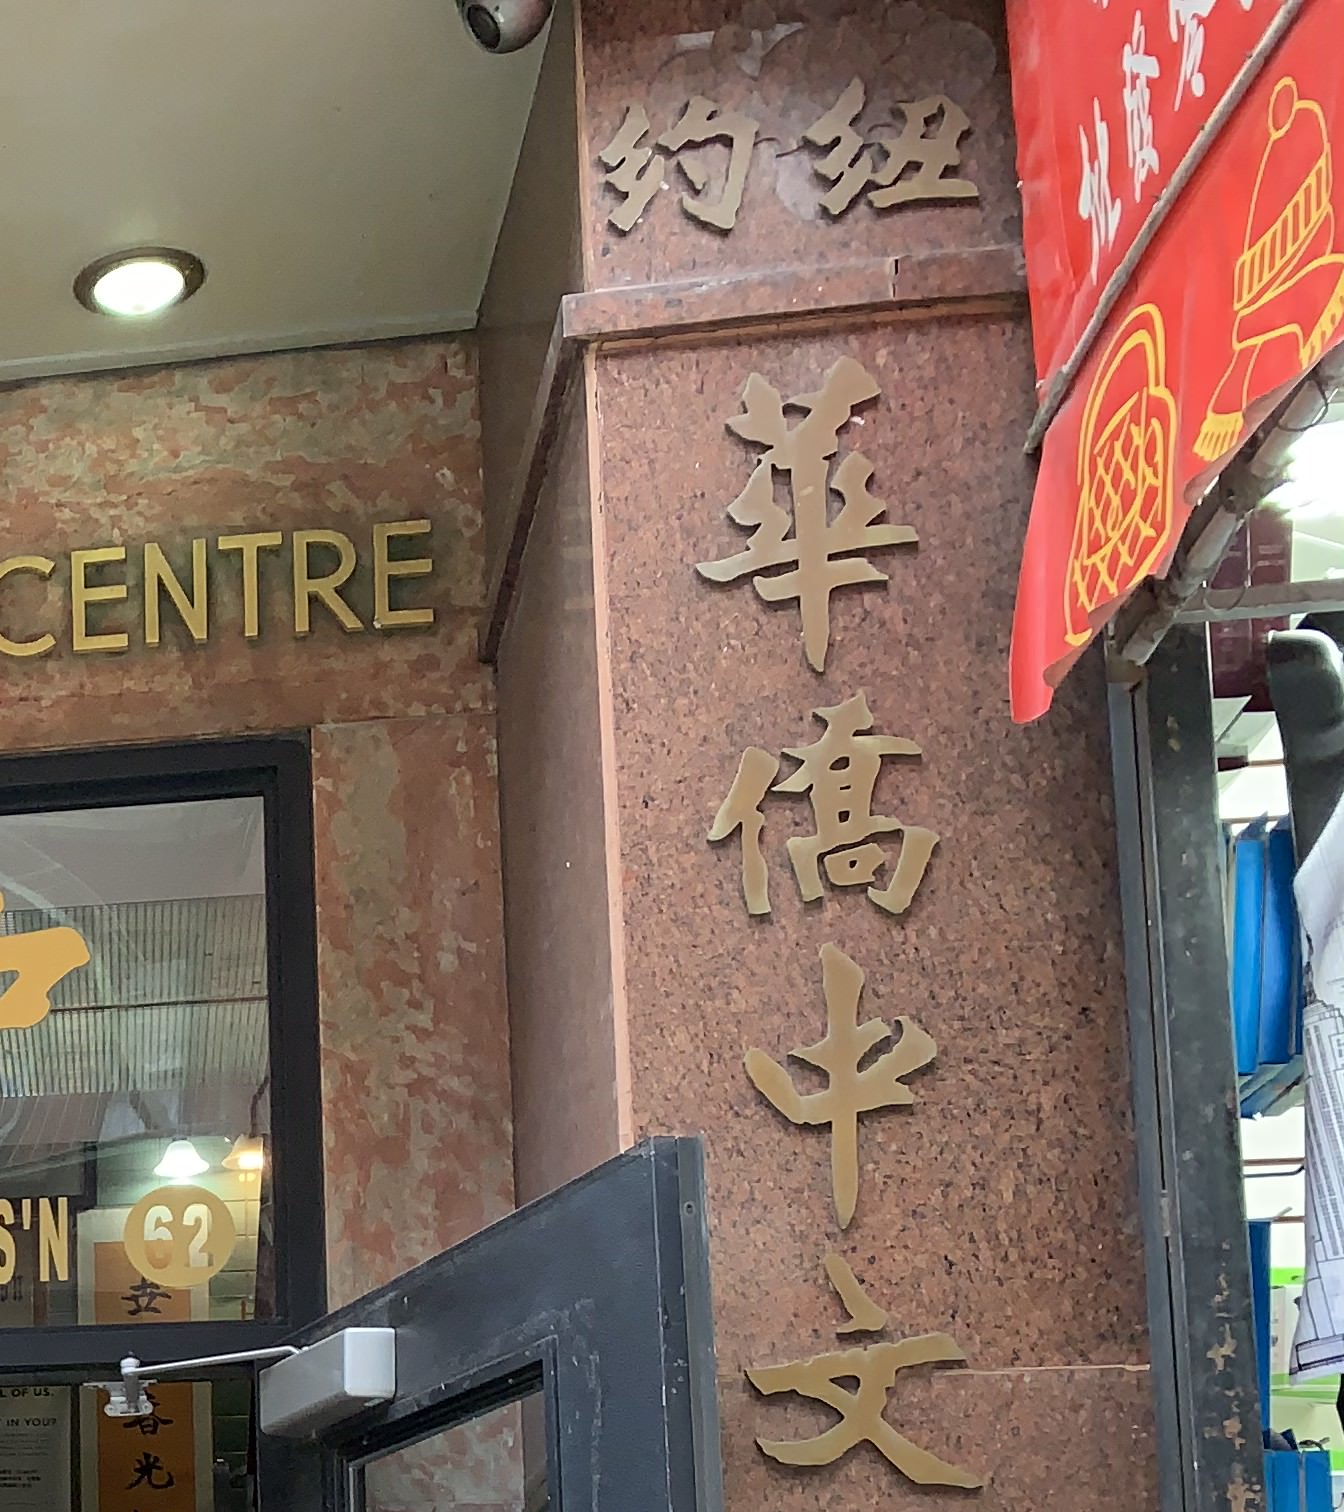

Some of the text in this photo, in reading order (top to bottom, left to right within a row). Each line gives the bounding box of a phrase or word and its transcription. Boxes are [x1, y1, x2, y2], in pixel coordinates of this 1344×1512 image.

[143, 1203, 210, 1270] 62
[11, 1388, 29, 1397] OF
[33, 1387, 54, 1396] US.
[6, 1419, 19, 1427] IN
[24, 1418, 57, 1426] YOU?
